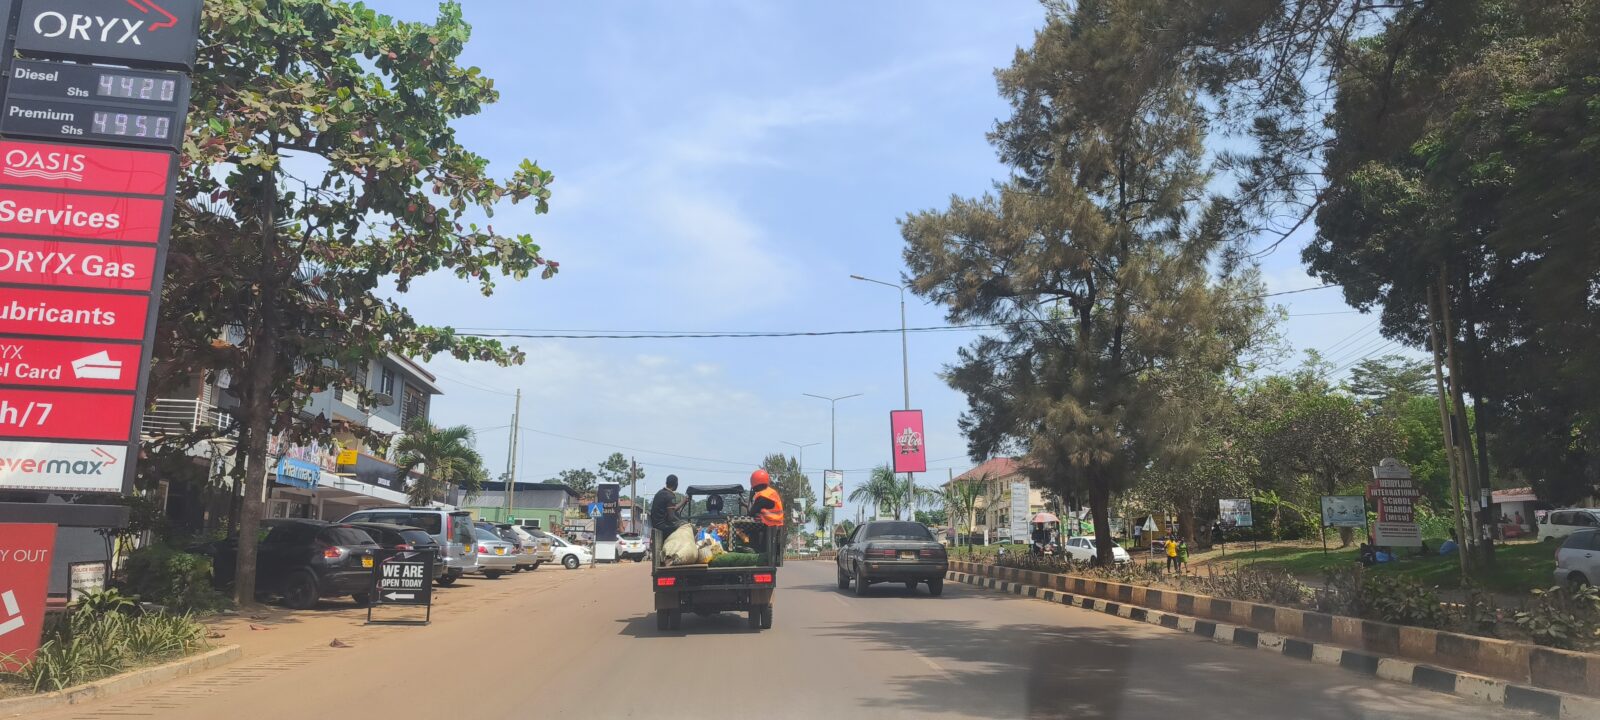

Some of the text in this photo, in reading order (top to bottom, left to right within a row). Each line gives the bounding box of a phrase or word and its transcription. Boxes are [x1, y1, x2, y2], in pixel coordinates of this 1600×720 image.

[33, 11, 144, 45] ORYX
[14, 67, 59, 82] Diesel
[67, 75, 176, 101] Shs 4420
[9, 106, 74, 122] Premium
[61, 112, 169, 139] Shs 4950
[5, 149, 86, 172] OASIS
[0, 200, 120, 229] Services
[81, 255, 135, 279] Gas
[15, 363, 62, 380] Card
[0, 400, 53, 428] h/7
[283, 459, 314, 485] Pharmacy
[13, 549, 48, 562] OUT
[383, 564, 425, 578] WE ARE
[381, 578, 423, 588] OPEN TODAY
